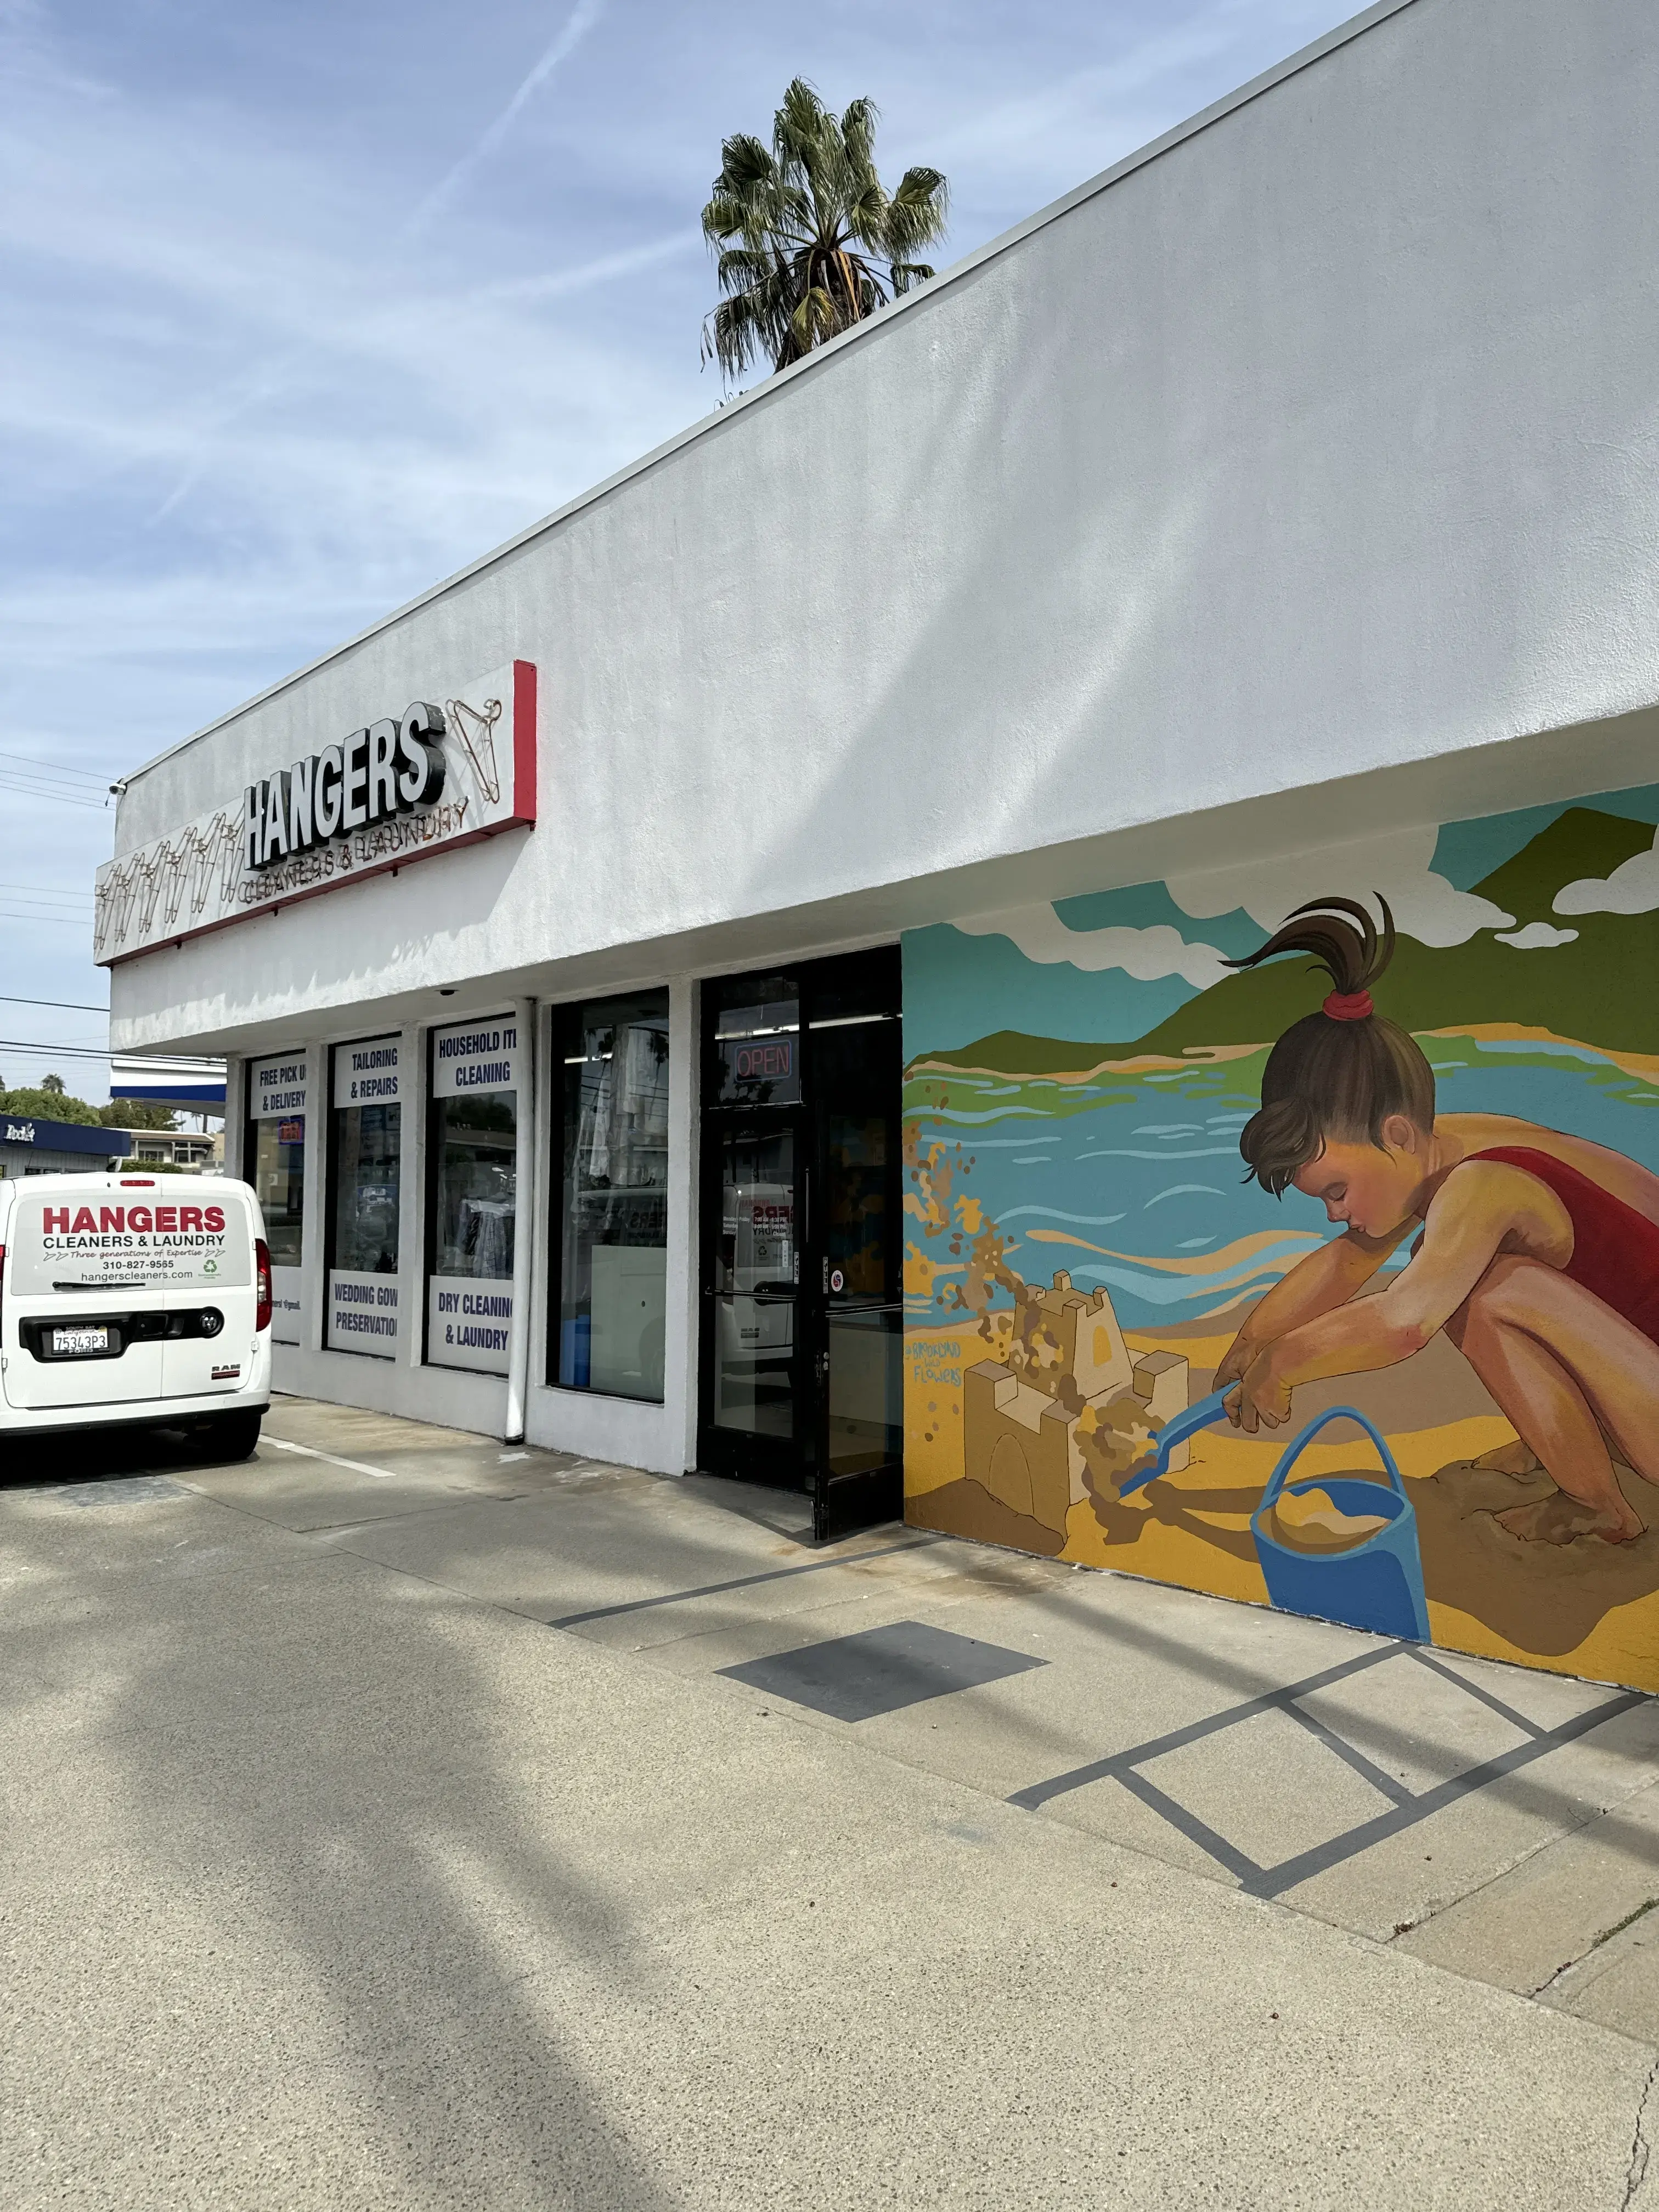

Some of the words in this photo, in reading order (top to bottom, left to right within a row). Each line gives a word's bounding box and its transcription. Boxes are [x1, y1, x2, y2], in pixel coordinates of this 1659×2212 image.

[244, 701, 446, 871] HANGERS
[439, 1031, 499, 1058] HOUSEHOLD
[352, 1048, 397, 1071] TAILORING
[737, 1045, 789, 1077] OPEN
[260, 1069, 278, 1087] FREE
[280, 1065, 297, 1084] PICK
[456, 1062, 510, 1087] CLEANING
[351, 1081, 358, 1098] &
[360, 1076, 398, 1098] REPAIRS
[263, 1095, 268, 1111] &
[270, 1090, 306, 1109] DELIVERY
[43, 1206, 225, 1234] HANGERS
[43, 1236, 133, 1249] CLEANERS
[138, 1236, 147, 1247] &
[153, 1235, 225, 1246] LAUNDRY
[100, 1250, 151, 1260] generations
[154, 1249, 163, 1258] of
[167, 1249, 203, 1258] Expertise
[103, 1260, 174, 1270] 310-827-9565
[81, 1271, 193, 1283] hangerscleaners.com
[335, 1284, 374, 1305] WEDDING
[439, 1293, 459, 1313] DRY
[462, 1294, 513, 1318] CLEANIN
[56, 1335, 106, 1350] 75343P3
[445, 1324, 454, 1344] &
[457, 1325, 509, 1351] LAUNDRY
[212, 1364, 240, 1372] RAM
